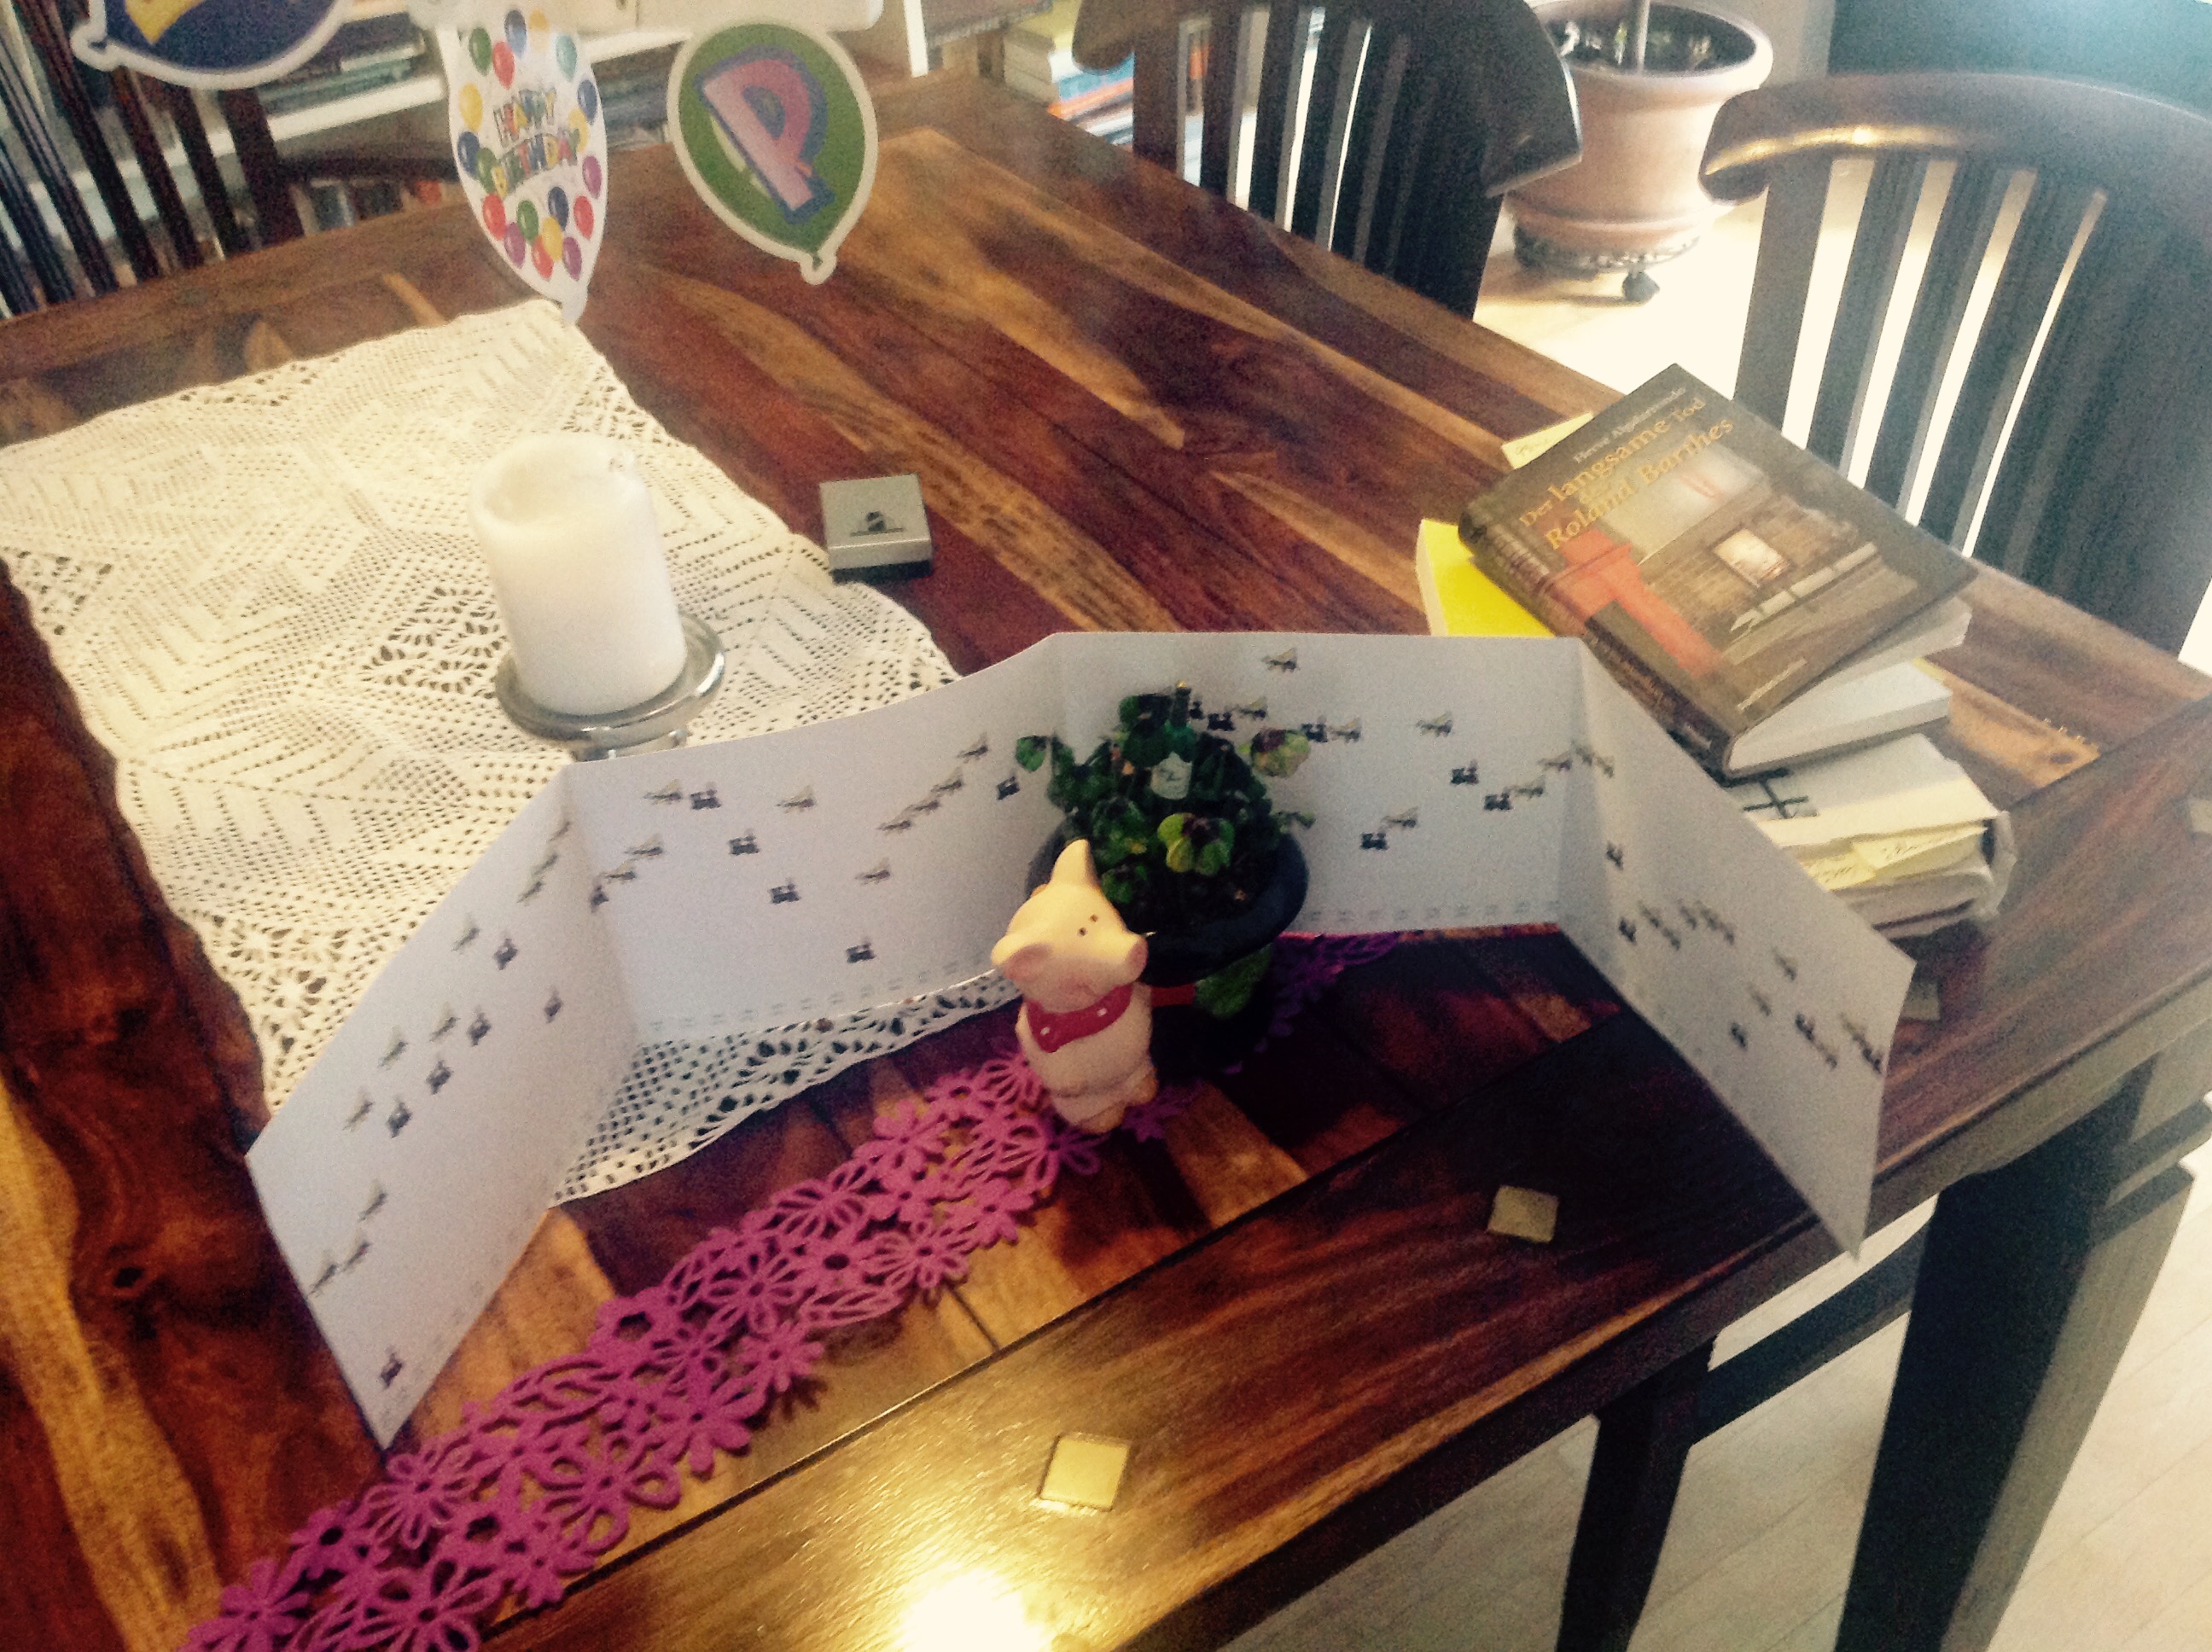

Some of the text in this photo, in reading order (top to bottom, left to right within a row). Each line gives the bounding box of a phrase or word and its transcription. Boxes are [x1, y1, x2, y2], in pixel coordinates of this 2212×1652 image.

[492, 87, 557, 148] HAPPY
[492, 127, 579, 201] BIRTHDAY
[1519, 499, 1554, 526] Der
[1548, 420, 1670, 501] langsame
[1671, 397, 1706, 422] Tod
[1545, 418, 1734, 550] Roland Barthes
